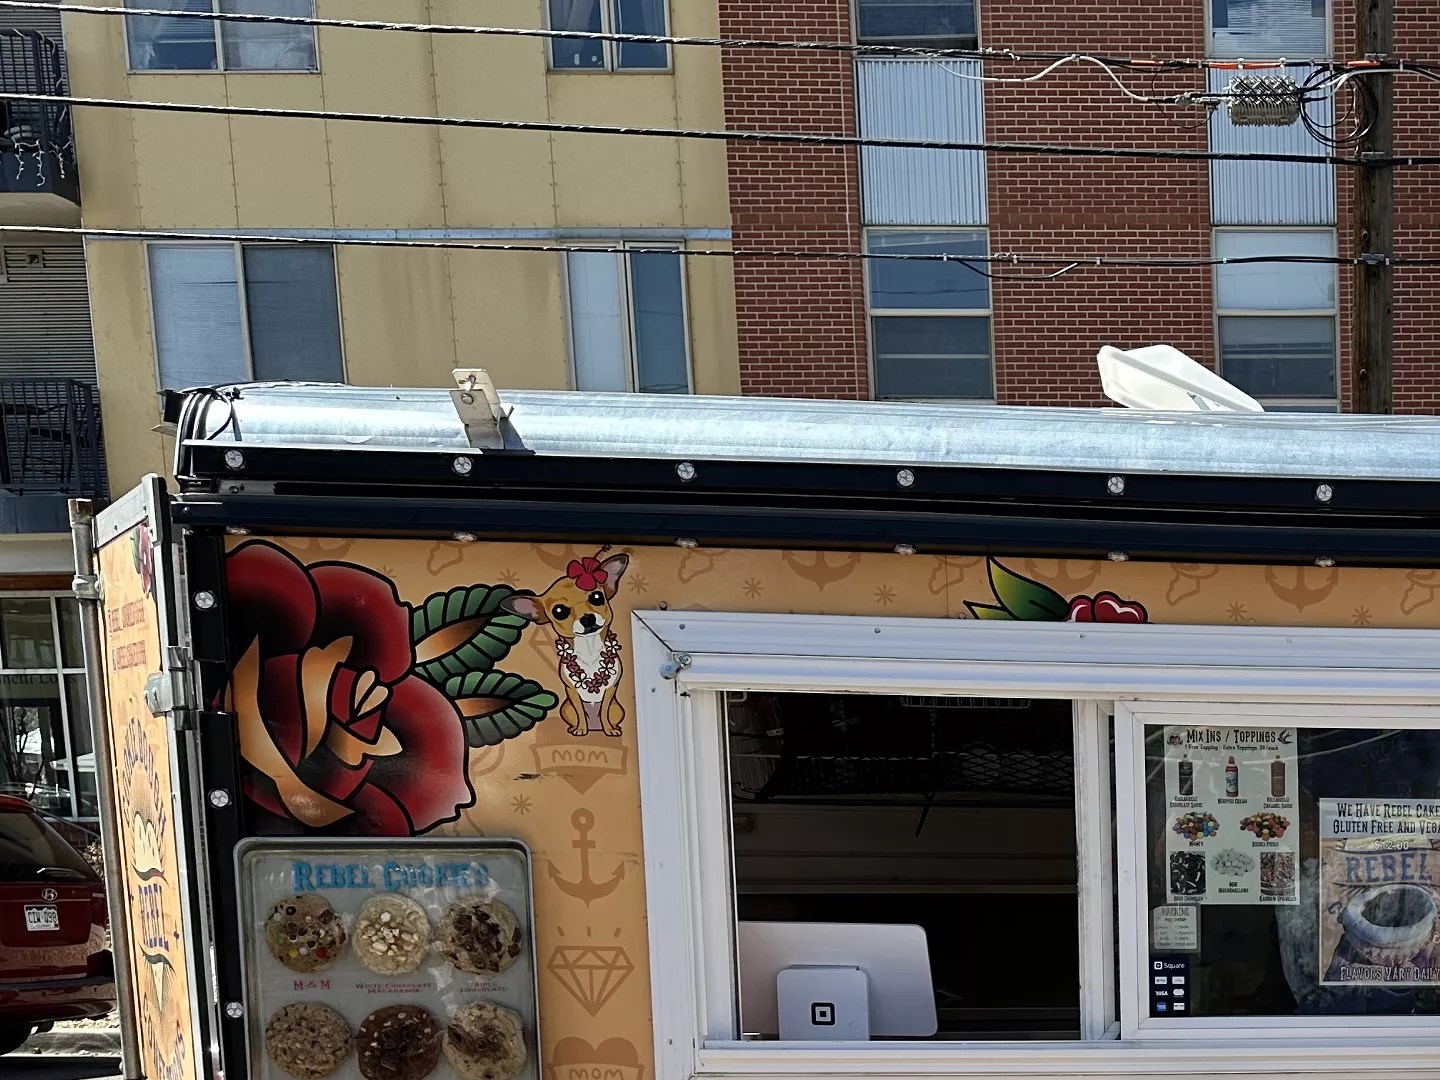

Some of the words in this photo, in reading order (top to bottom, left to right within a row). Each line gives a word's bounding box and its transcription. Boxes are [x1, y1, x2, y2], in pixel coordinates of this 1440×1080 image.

[1186, 729, 1204, 743] MIX
[1206, 730, 1221, 743] INS
[1234, 730, 1276, 743] TOPPINGS
[552, 748, 609, 764] MOM
[1337, 803, 1352, 817] WE
[1356, 803, 1380, 817] HAVE
[1384, 803, 1412, 817] REBEL
[1333, 820, 1368, 834] GLUTEN
[1371, 820, 1394, 834] FREE
[1397, 822, 1415, 833] AND
[1346, 854, 1432, 883] REBEL
[292, 862, 376, 891] REBEL
[1340, 967, 1382, 981] FLAVORS
[1386, 967, 1411, 981] VARY
[1413, 967, 1440, 981] DAILY
